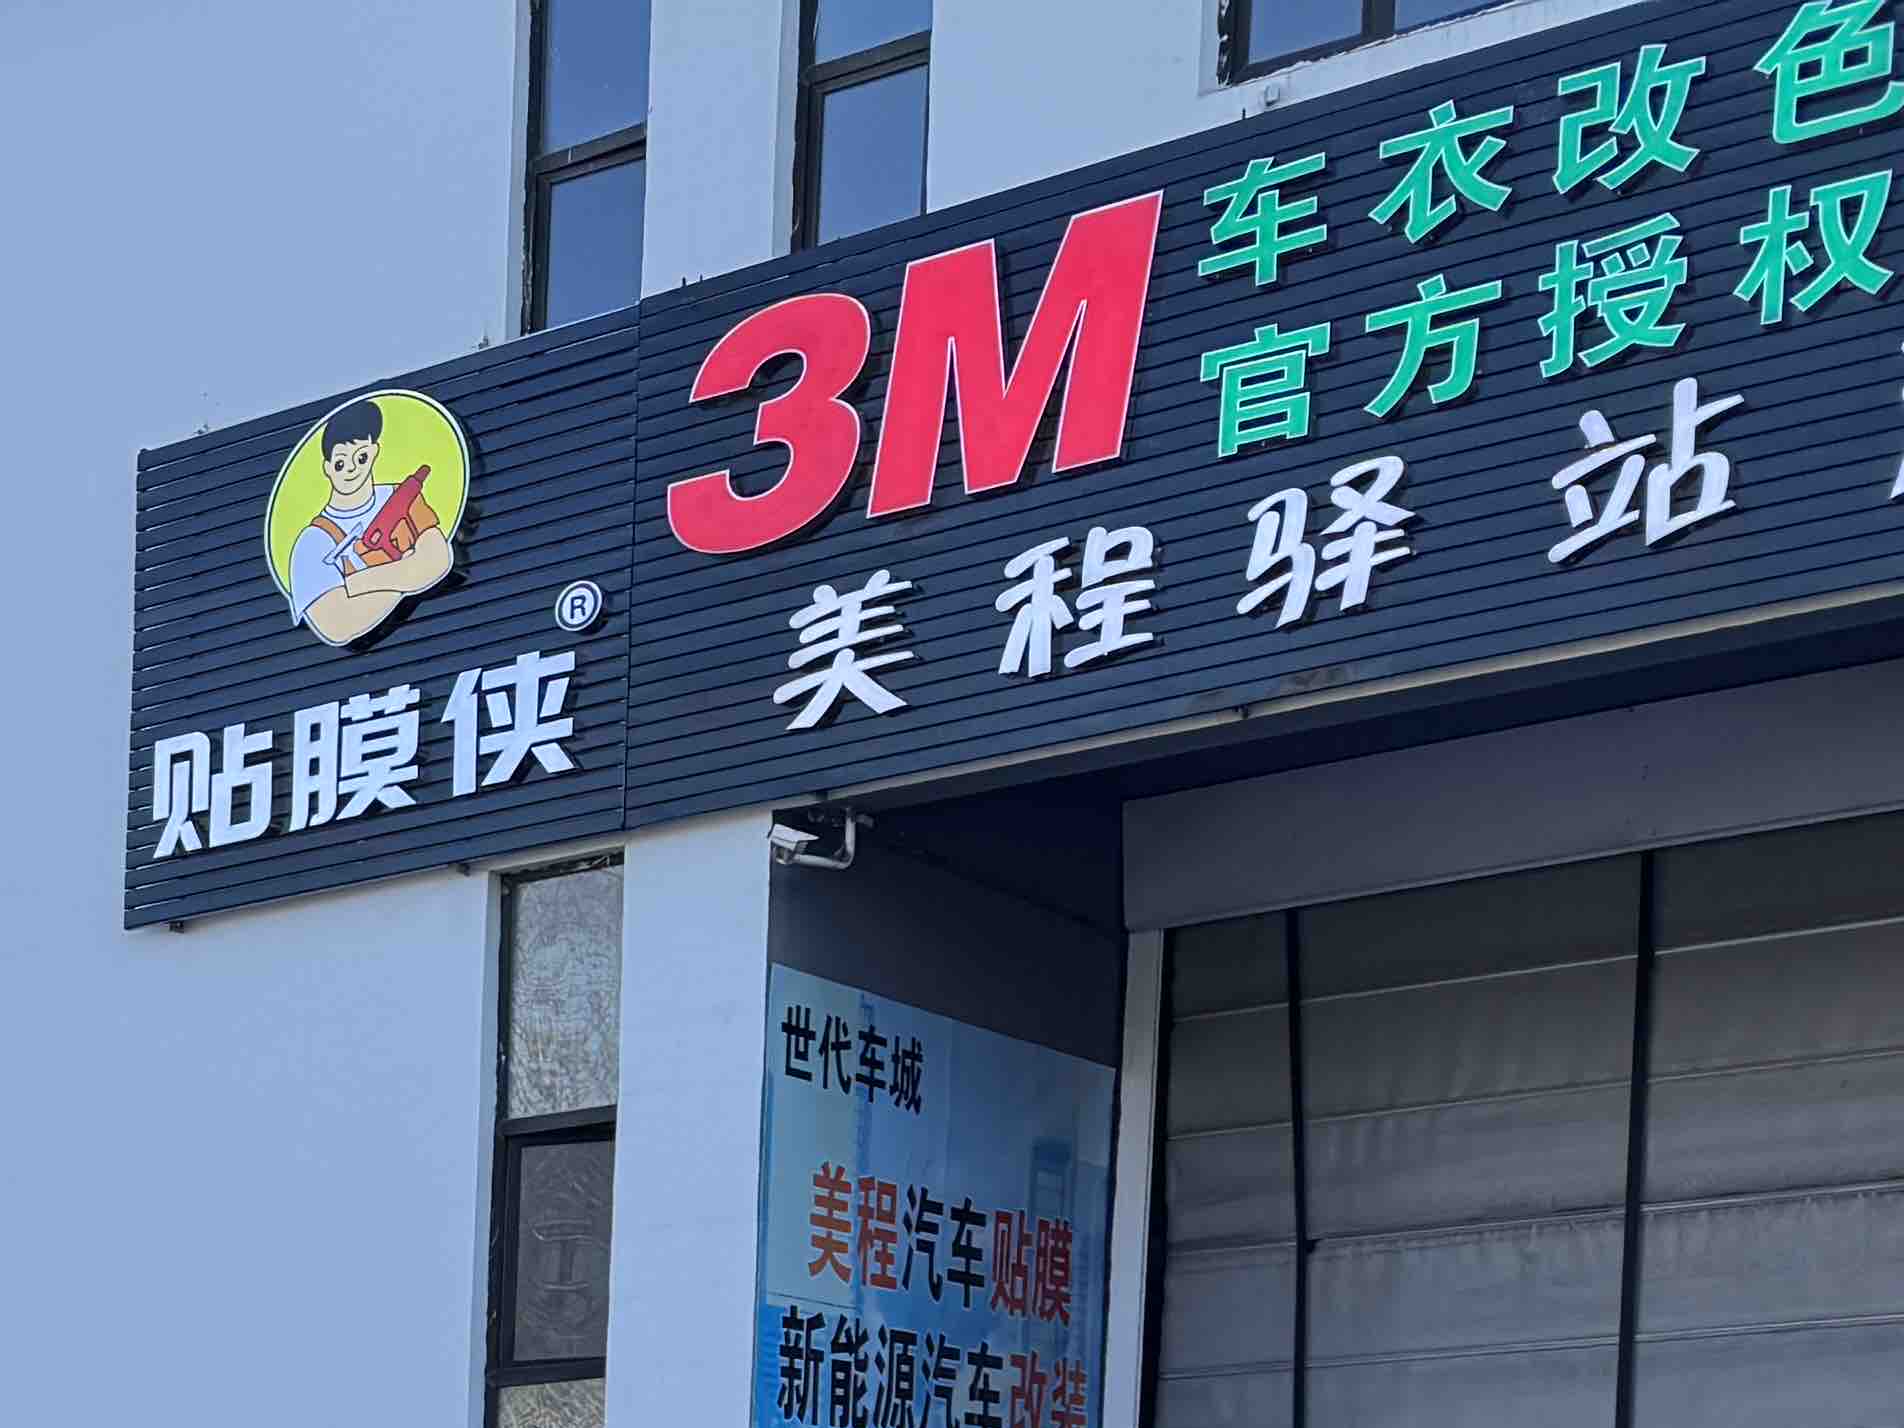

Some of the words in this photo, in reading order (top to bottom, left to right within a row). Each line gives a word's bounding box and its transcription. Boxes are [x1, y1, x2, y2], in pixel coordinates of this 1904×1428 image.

[1198, 0, 1904, 286] 车衣改色
[666, 190, 1164, 554] 3M
[1200, 168, 1894, 456] 官方授权
[772, 340, 1904, 730] 美程驿站
[152, 648, 578, 860] 贴膜侠
[781, 1005, 923, 1114] 世代车城
[808, 1160, 1072, 1326] 美程汽车贴膜
